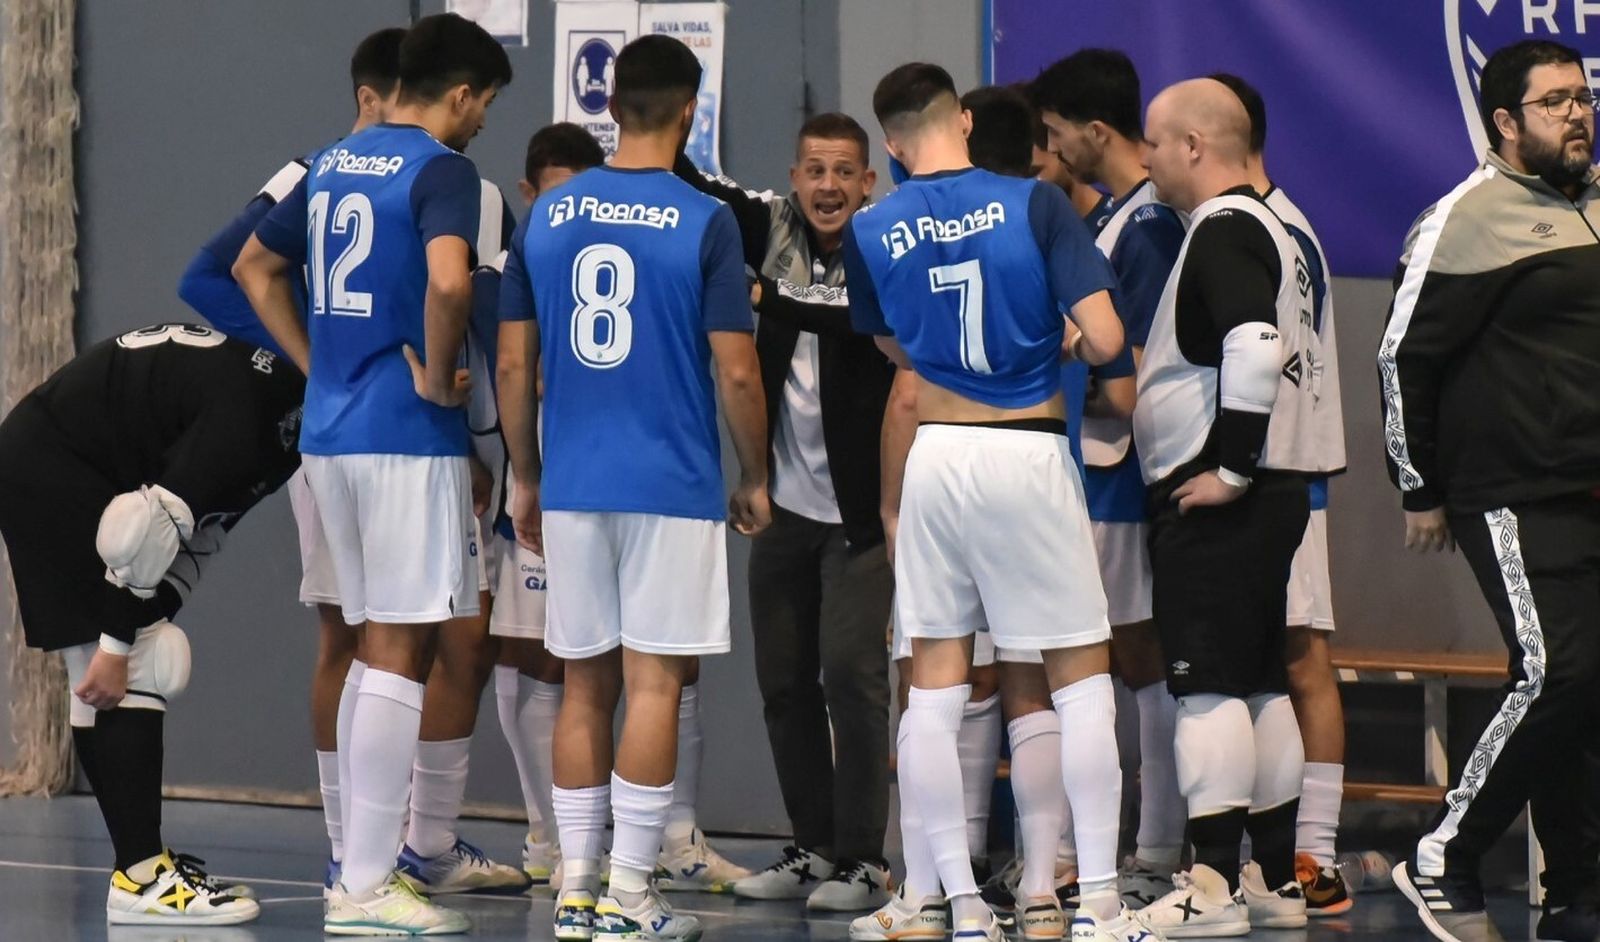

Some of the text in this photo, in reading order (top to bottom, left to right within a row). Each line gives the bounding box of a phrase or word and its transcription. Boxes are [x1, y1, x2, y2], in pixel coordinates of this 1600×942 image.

[652, 21, 680, 33] SALVA
[308, 191, 374, 318] 12
[570, 243, 635, 369] 8
[928, 258, 993, 375] 7
